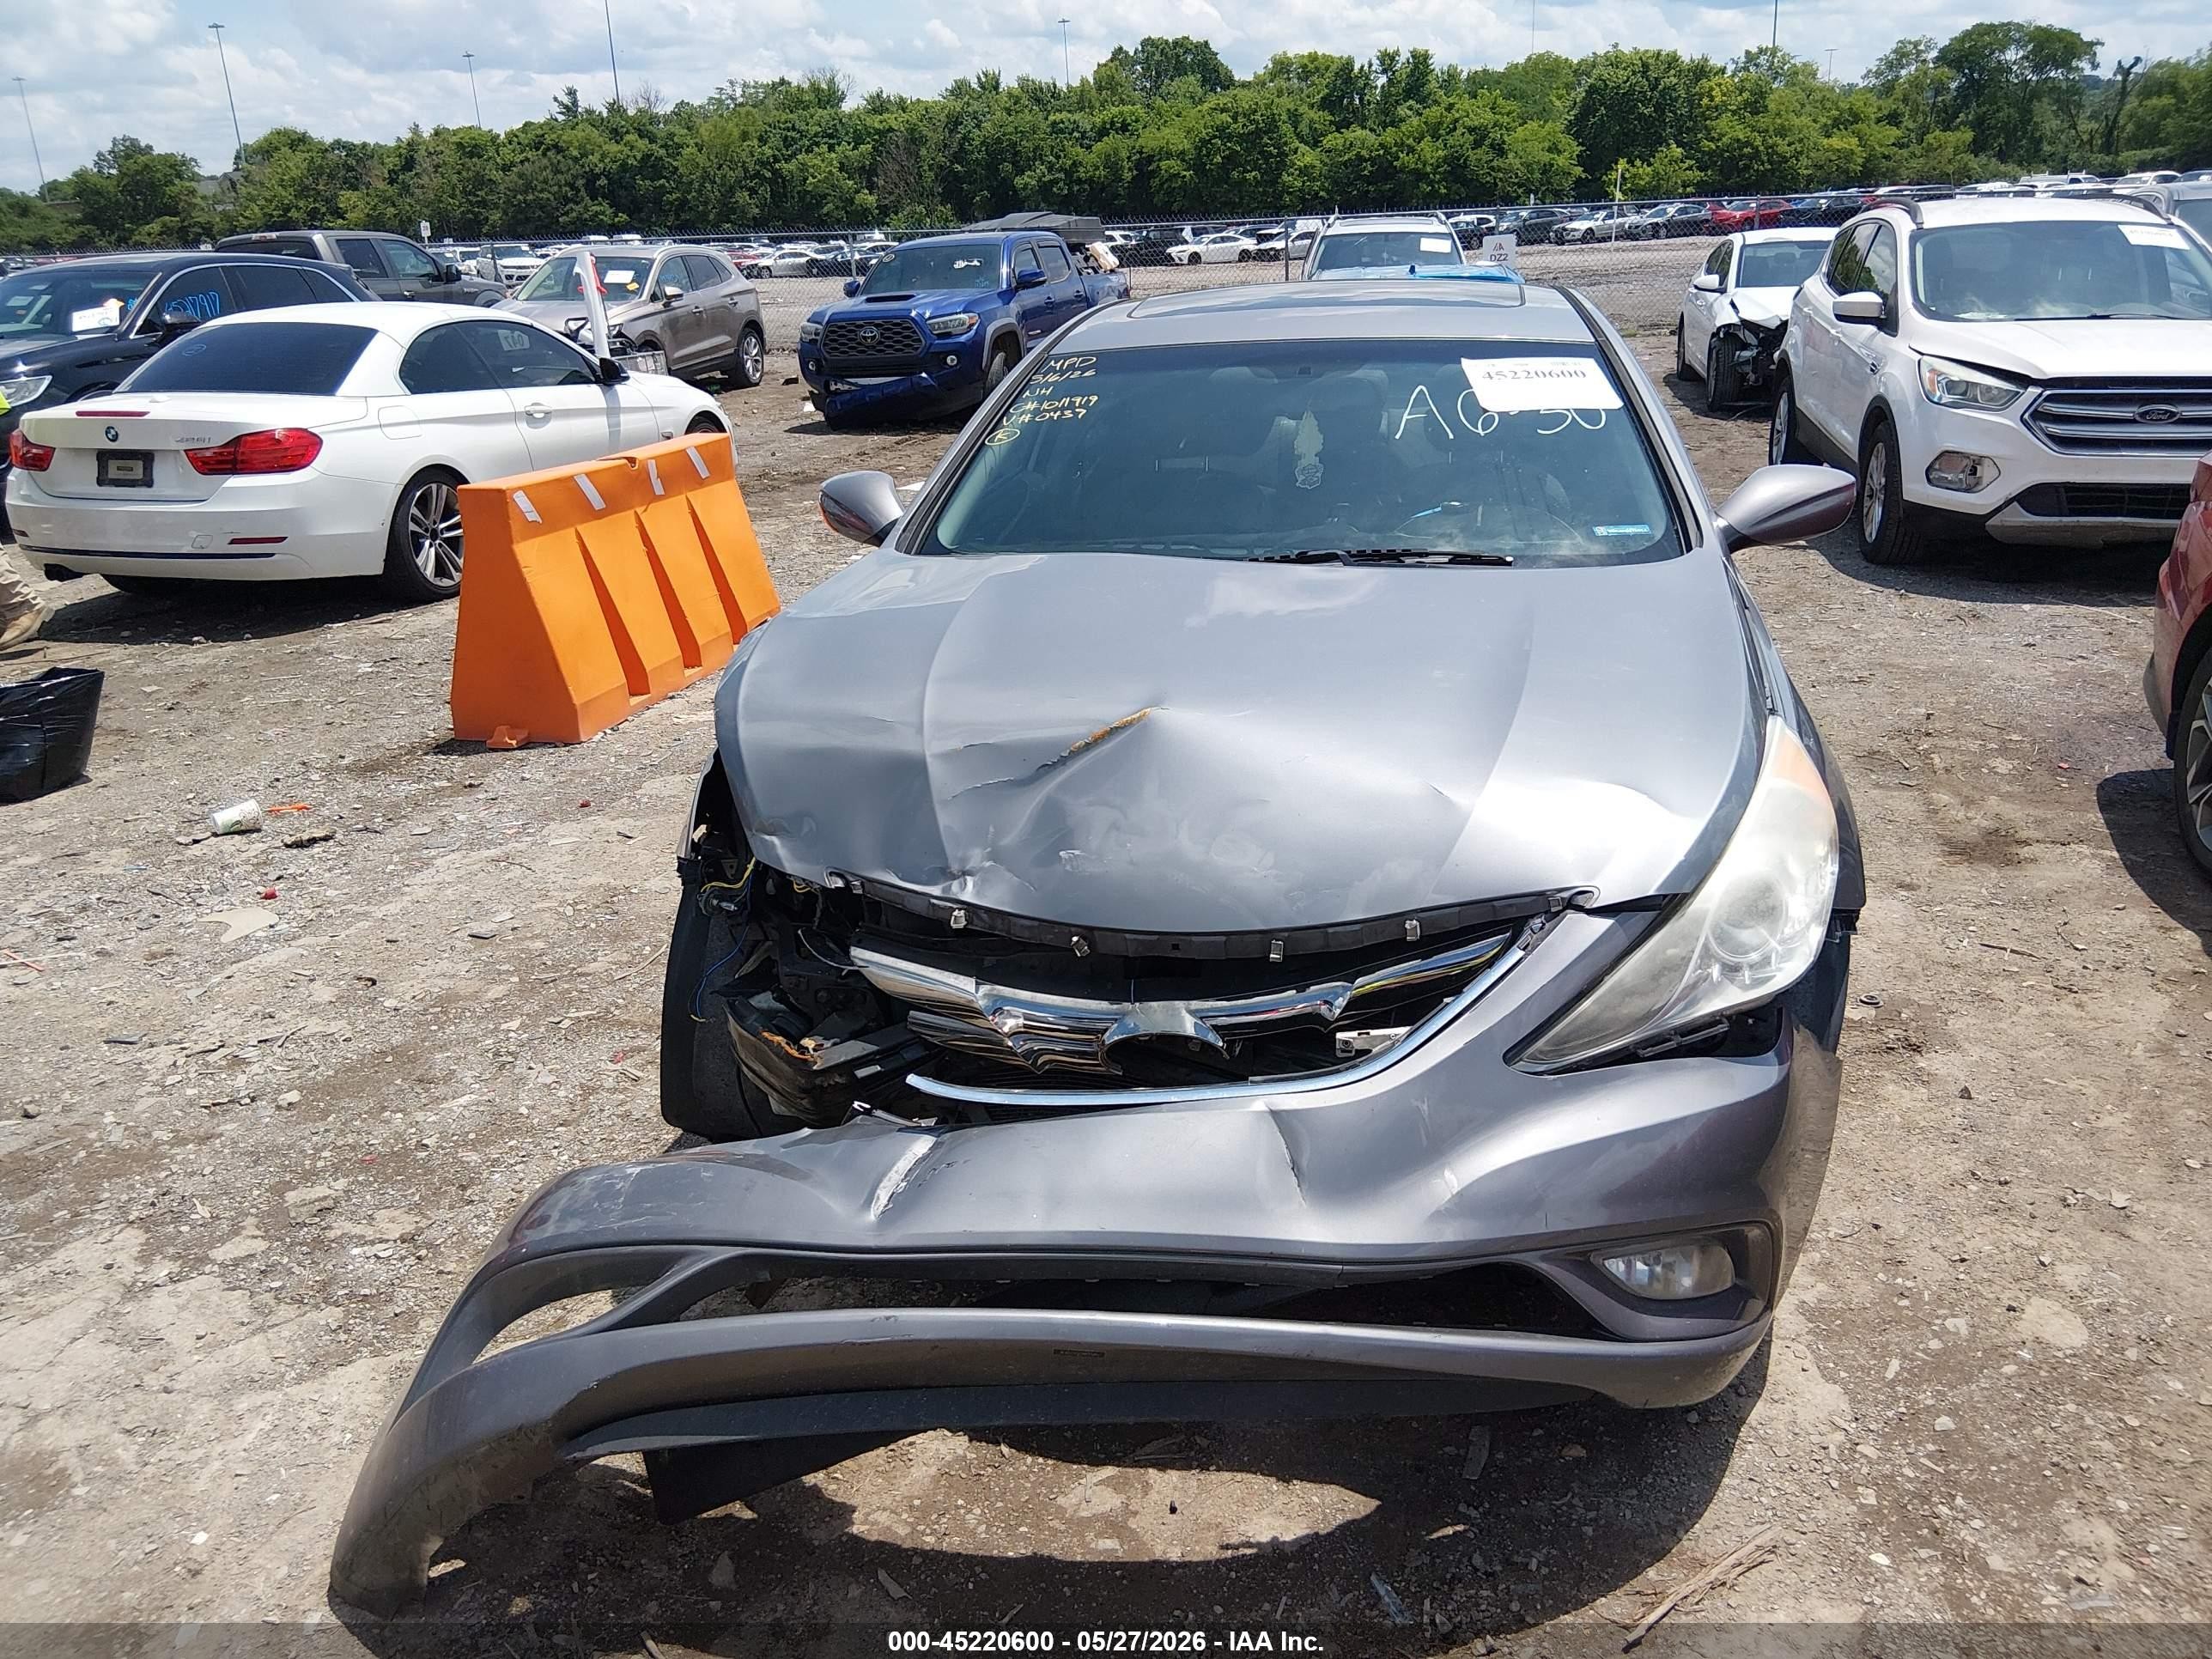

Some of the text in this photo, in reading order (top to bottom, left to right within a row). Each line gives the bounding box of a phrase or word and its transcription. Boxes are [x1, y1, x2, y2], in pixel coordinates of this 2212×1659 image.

[1490, 252, 1509, 262] DZ2
[1041, 356, 1097, 373] MPD
[1030, 368, 1097, 385] 5/6/26
[1482, 369, 1587, 380] 45220600
[2146, 410, 2171, 420] Ford
